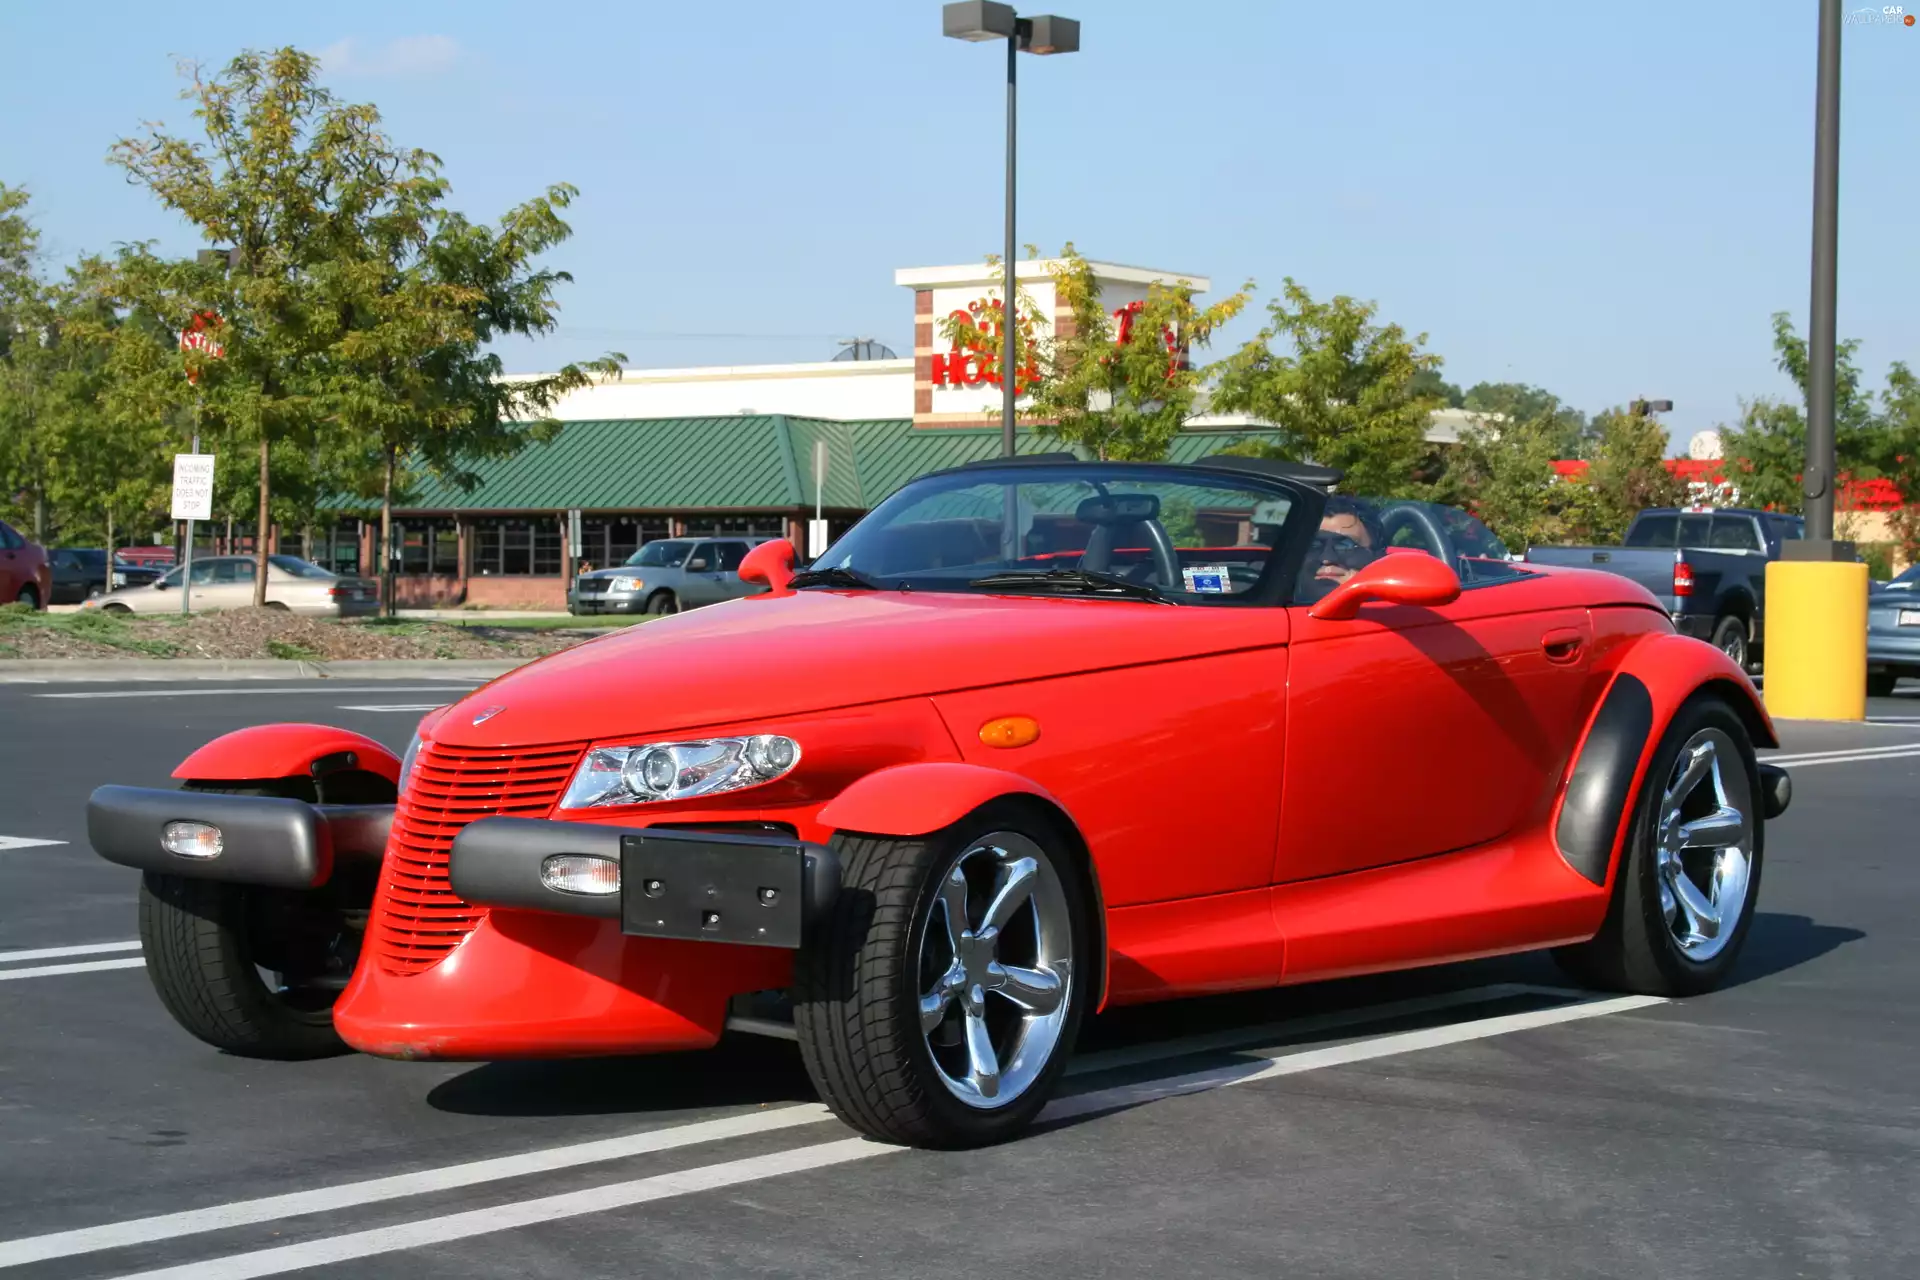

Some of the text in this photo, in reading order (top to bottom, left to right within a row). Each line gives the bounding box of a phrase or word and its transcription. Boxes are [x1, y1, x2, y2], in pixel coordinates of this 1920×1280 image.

[178, 463, 210, 473] INCOMING
[180, 475, 207, 485] TRAFFIC
[176, 488, 209, 498] DOES NOT
[183, 500, 201, 510] STOP
